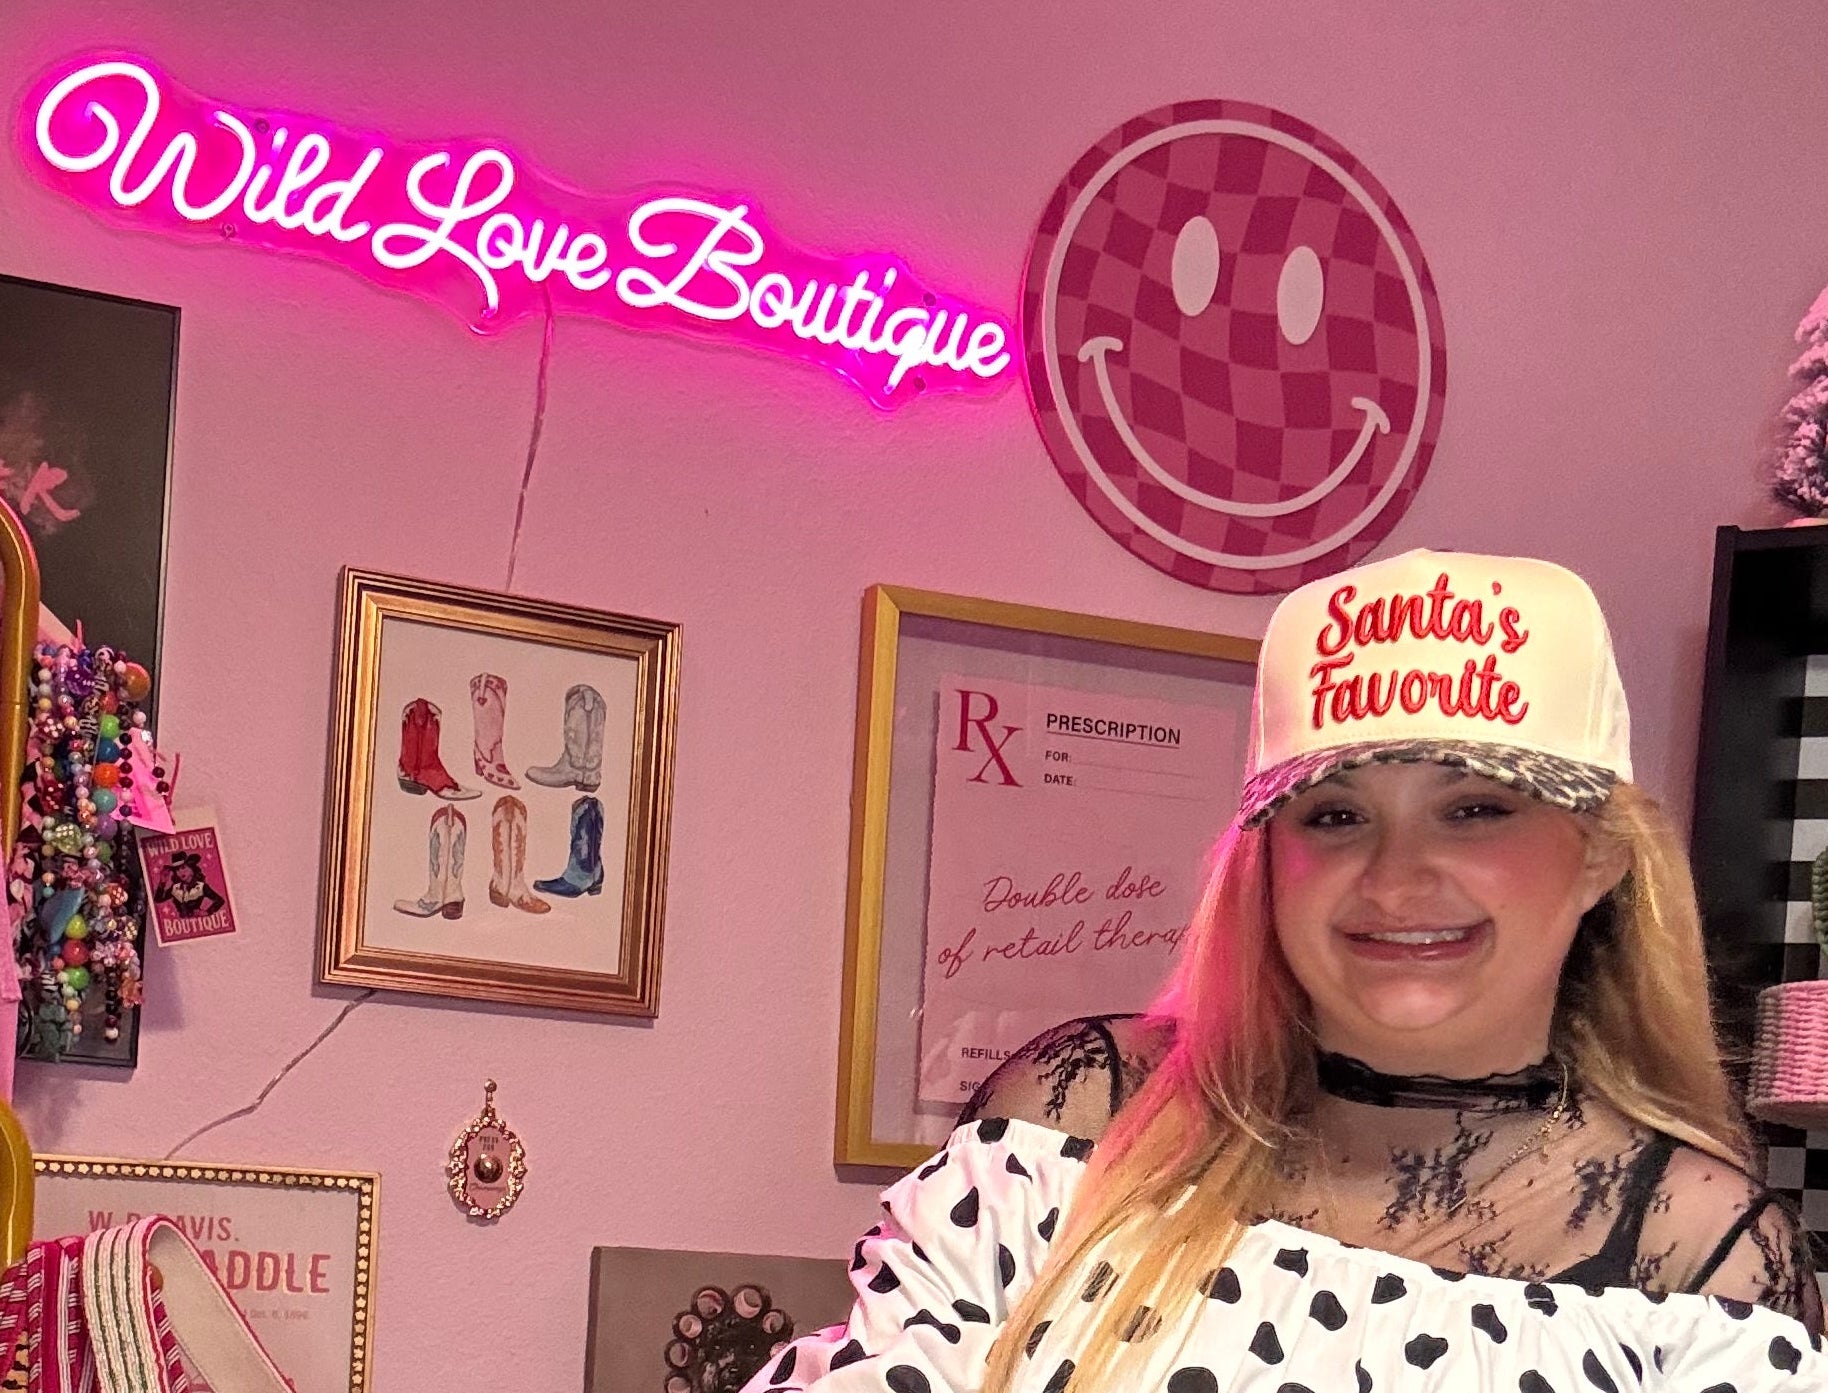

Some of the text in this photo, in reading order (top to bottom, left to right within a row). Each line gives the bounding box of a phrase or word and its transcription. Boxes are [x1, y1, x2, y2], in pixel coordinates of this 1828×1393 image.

[36, 60, 1012, 396] Wild Love Boutique
[1316, 572, 1529, 657] Santa's
[1310, 653, 1529, 730] Favorite
[1046, 713, 1181, 745] PRESCRIPTION
[147, 832, 214, 858] WILD LOVE
[983, 866, 1167, 913] Double dose
[163, 910, 230, 937] BOUTIQUE
[938, 910, 1191, 980] of retail therap
